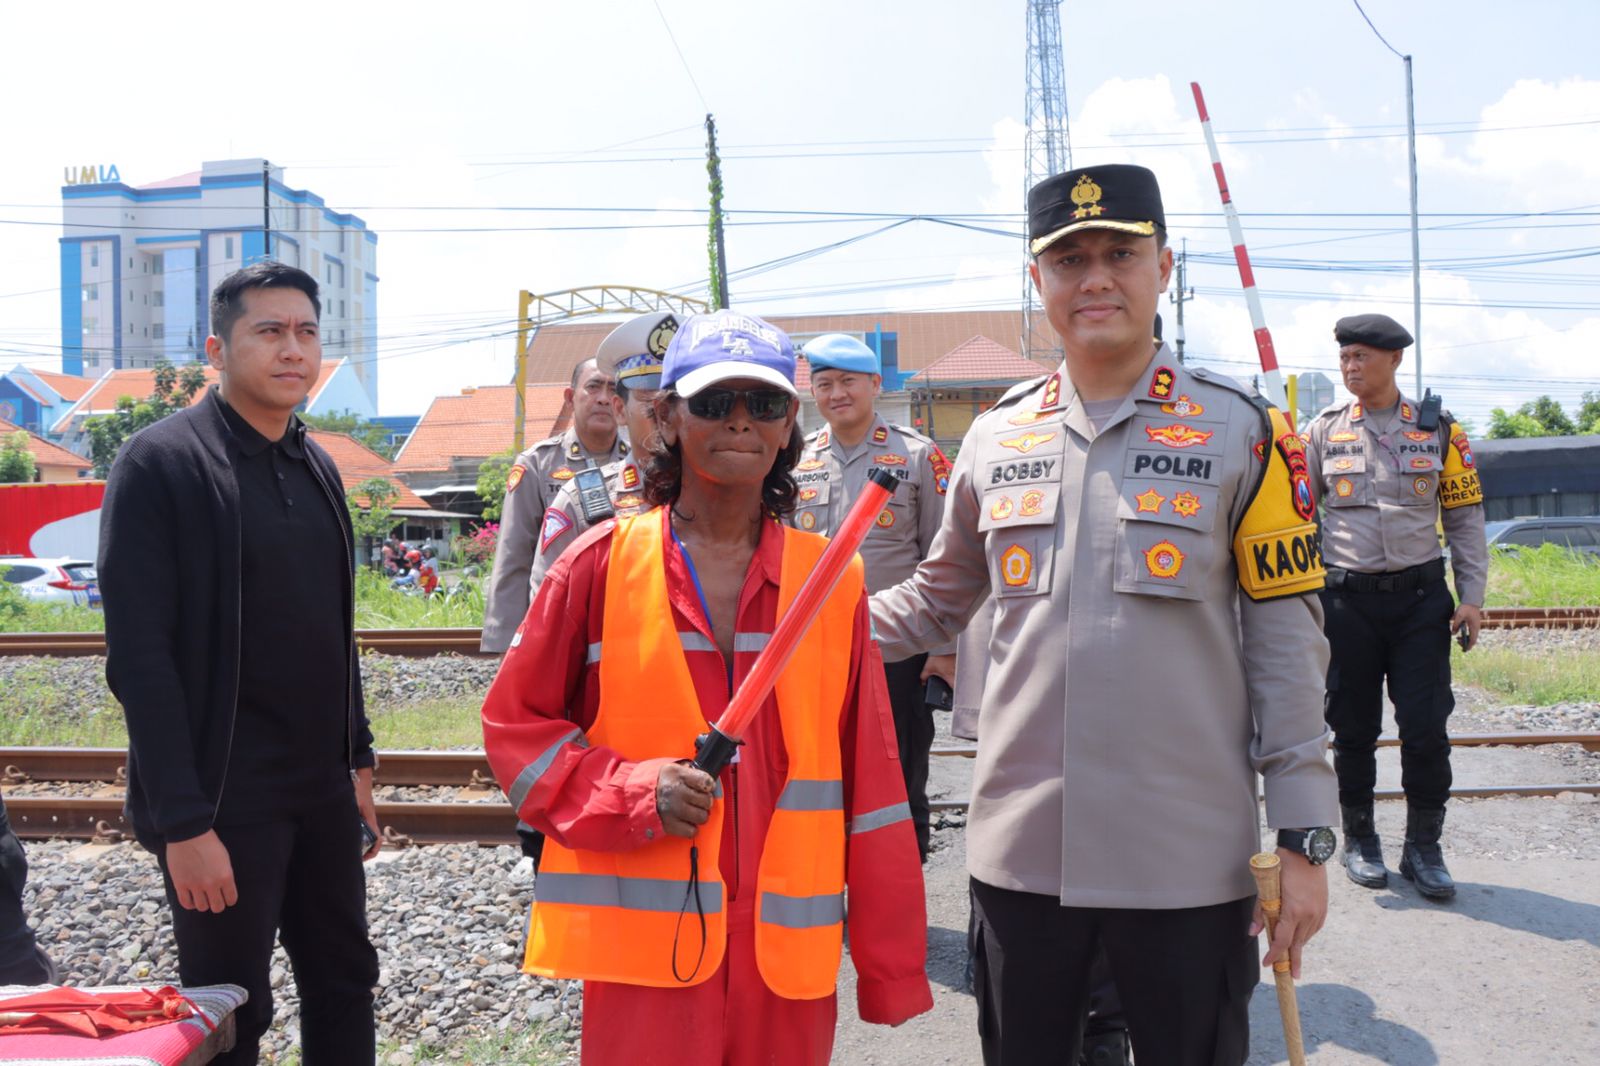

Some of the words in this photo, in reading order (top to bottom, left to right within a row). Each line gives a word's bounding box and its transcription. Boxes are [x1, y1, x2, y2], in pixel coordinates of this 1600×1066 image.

[721, 331, 753, 356] LA
[1400, 444, 1439, 455] POLRI
[991, 460, 1056, 484] BOBBY
[1134, 454, 1212, 480] POLRI
[1440, 479, 1459, 494] KA
